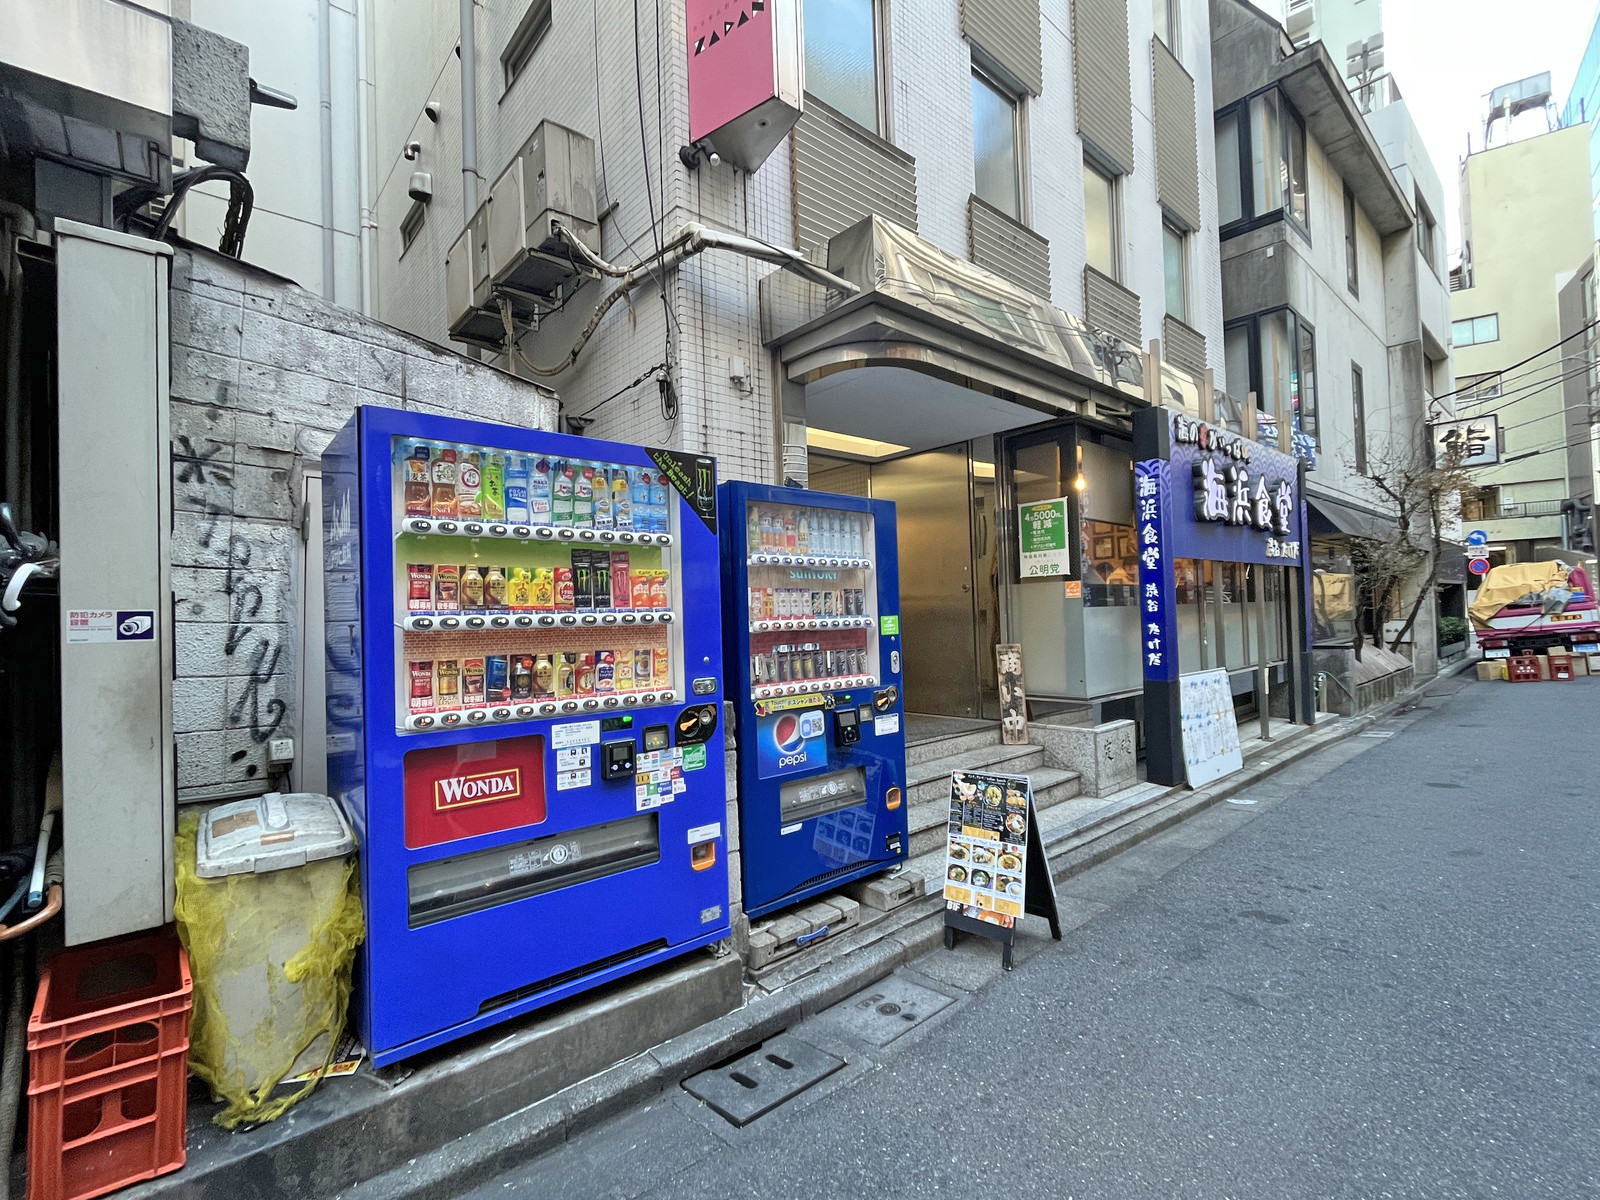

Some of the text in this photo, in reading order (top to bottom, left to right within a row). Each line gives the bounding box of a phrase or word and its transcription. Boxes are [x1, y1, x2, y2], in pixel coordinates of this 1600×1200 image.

[652, 452, 667, 471] the
[662, 451, 692, 488] Unleash
[1196, 454, 1293, 536] 海浜食堂
[410, 572, 431, 580] WONDA
[1029, 563, 1060, 576] 公明党
[1138, 474, 1164, 667] 海浜食堂 渋谷 たけだ
[69, 611, 113, 619] 防犯カメラ
[411, 670, 432, 678] WONDA
[439, 669, 459, 677] WONDA
[464, 666, 485, 674] WONDA
[778, 751, 807, 768] pepsi
[439, 776, 515, 803] WONDA
